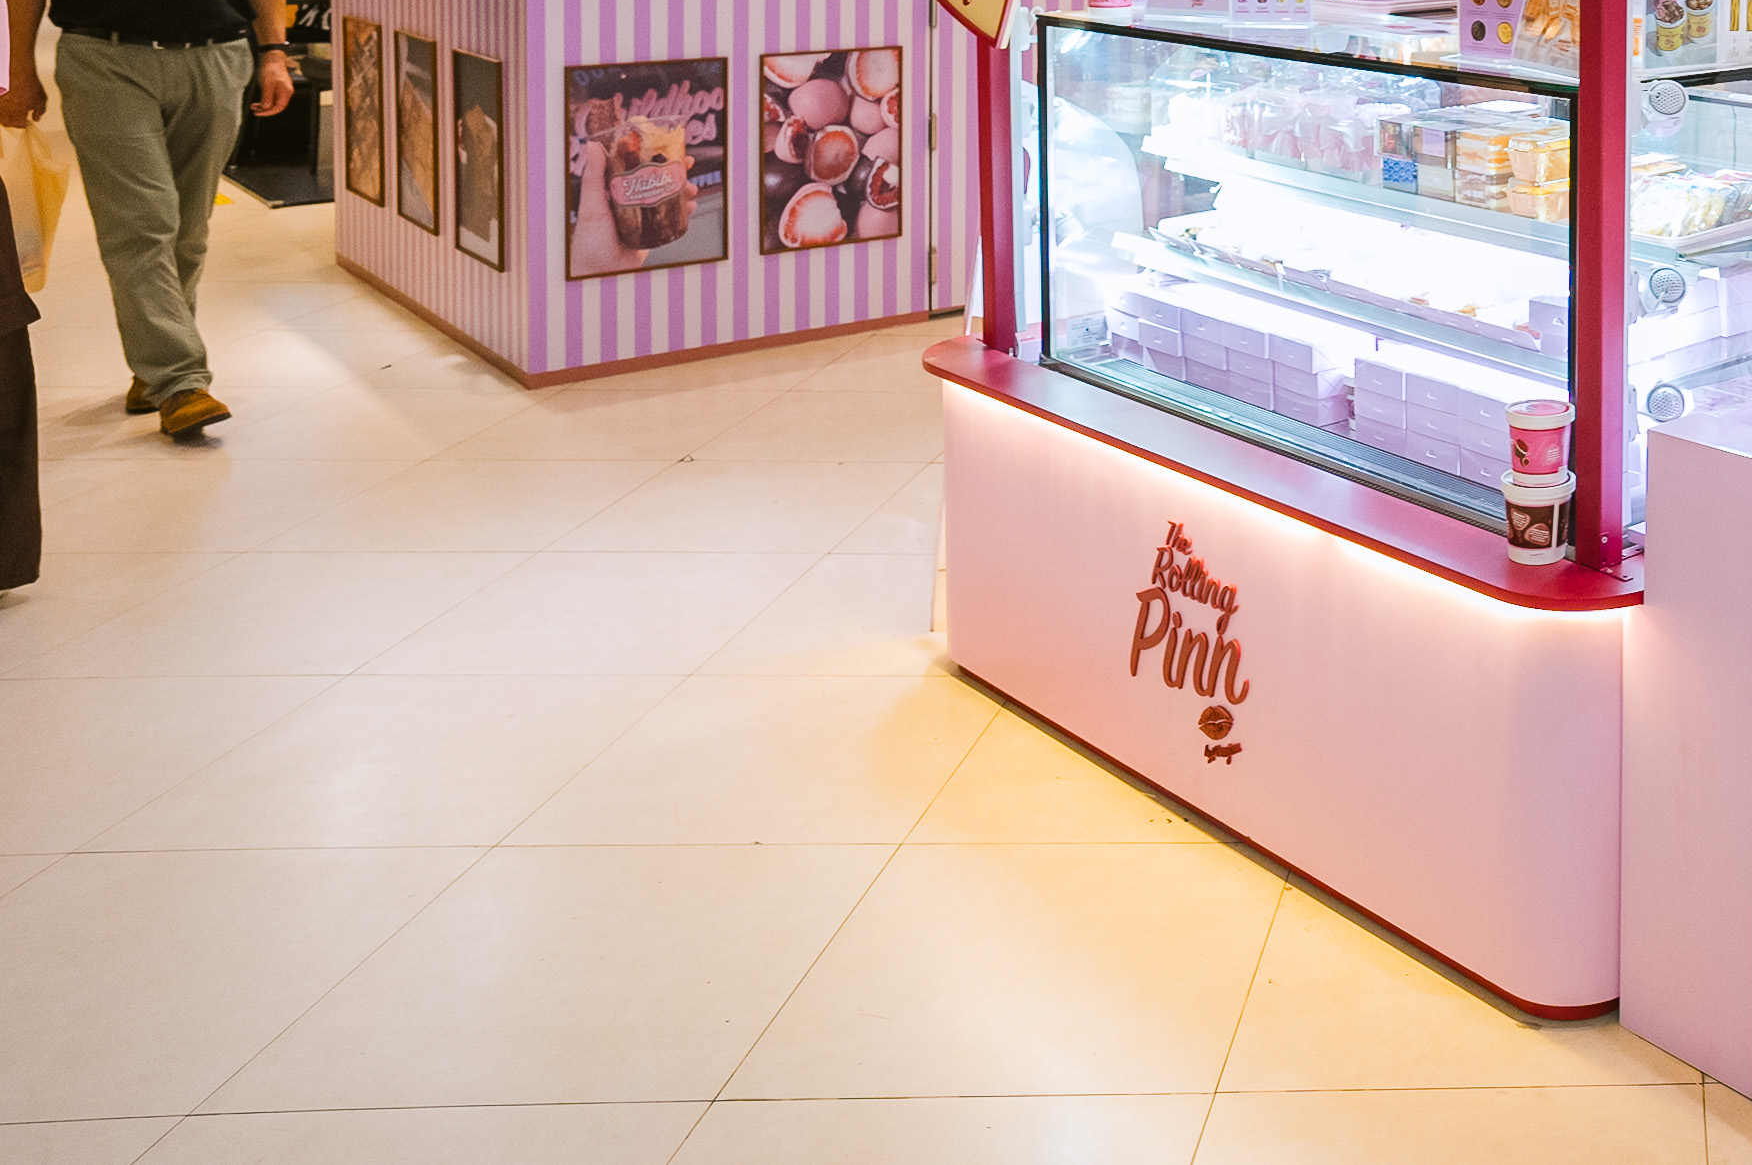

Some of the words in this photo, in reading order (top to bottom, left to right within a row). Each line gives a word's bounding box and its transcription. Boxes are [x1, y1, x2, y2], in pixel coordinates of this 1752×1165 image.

[1166, 520, 1193, 555] The
[1152, 545, 1239, 636] Rolling
[1130, 587, 1249, 705] Pinn
